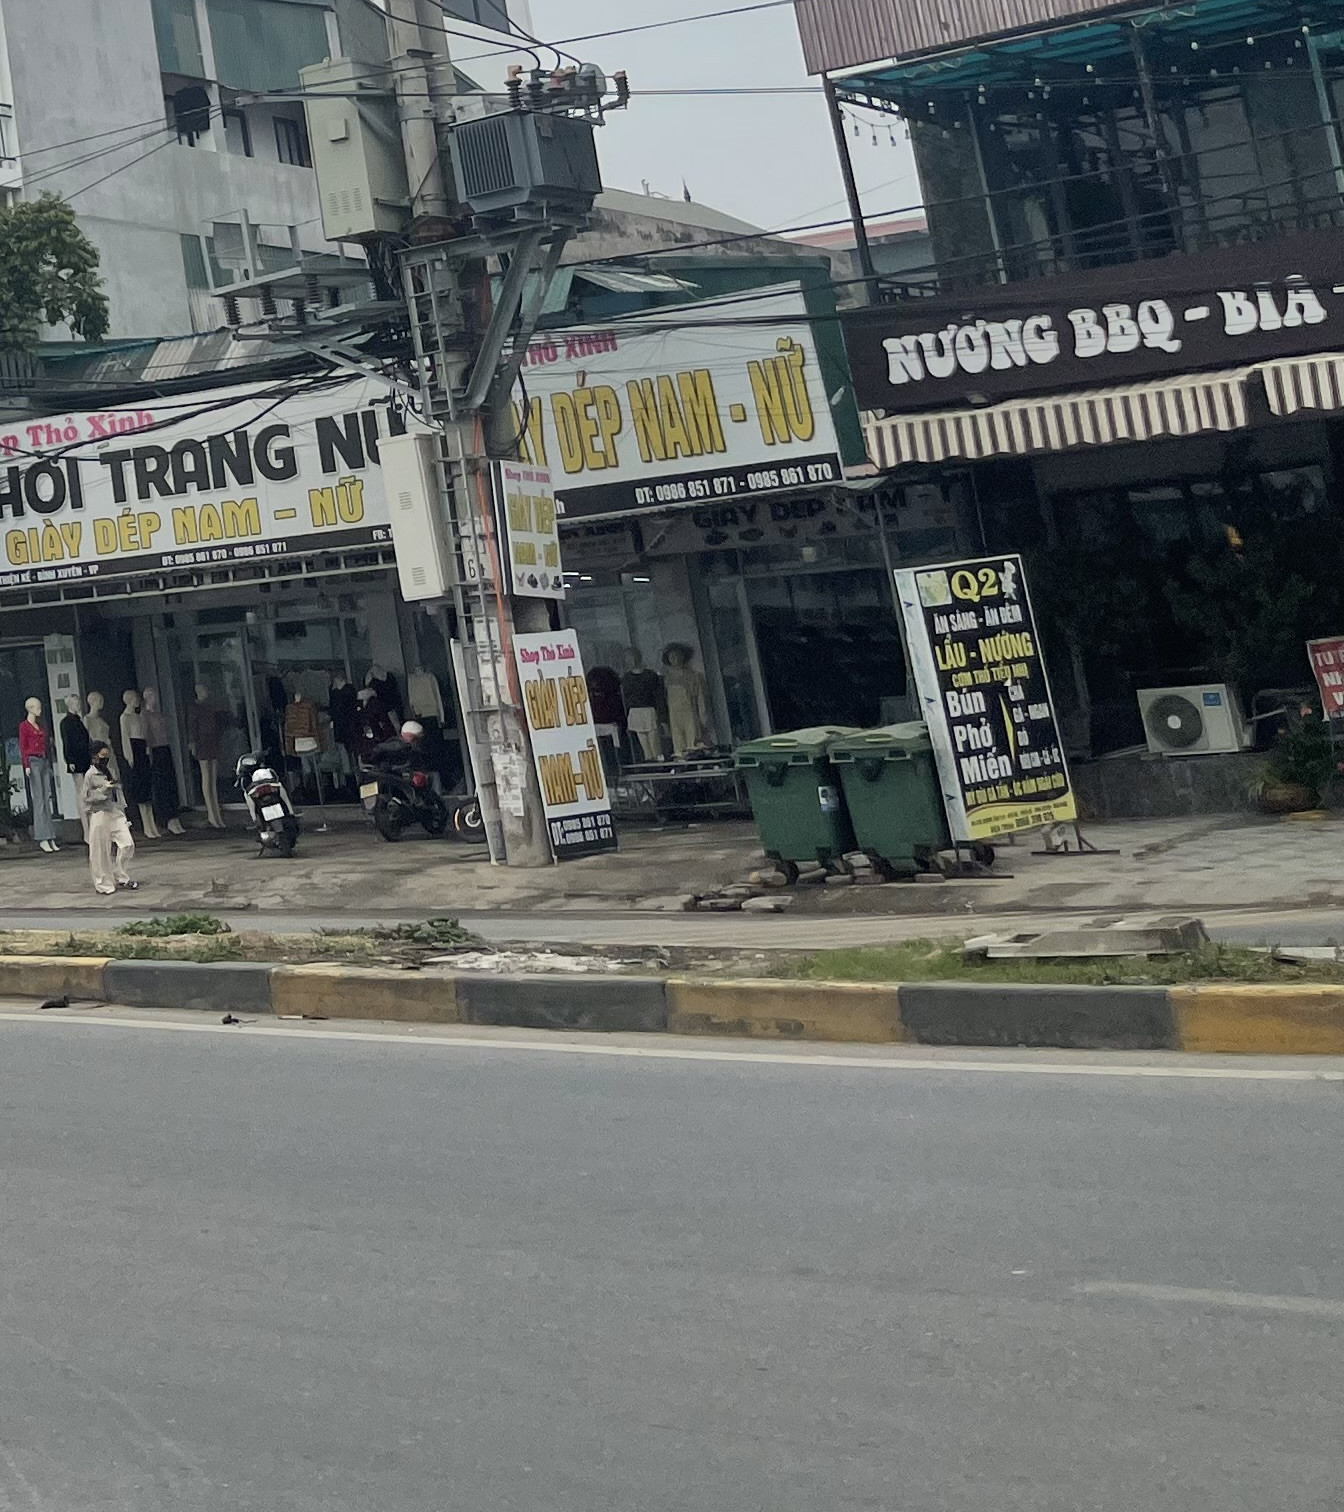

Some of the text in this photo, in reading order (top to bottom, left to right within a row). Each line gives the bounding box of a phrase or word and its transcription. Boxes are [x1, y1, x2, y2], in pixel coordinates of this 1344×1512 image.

[1067, 299, 1182, 358] BBQ
[1216, 275, 1328, 335] BIA
[550, 370, 621, 474] DÉP
[627, 368, 727, 463] NAM
[747, 335, 816, 446] NỮ
[26, 417, 79, 447] Thỏ
[86, 410, 156, 439] Xinh
[99, 423, 300, 505] TRANG
[655, 463, 833, 501] 0986 851 871 0985 861 870
[5, 474, 365, 565] GIÀY DÉP NAM NỮ
[950, 567, 999, 603] Q2
[949, 608, 978, 633] SÁNG
[558, 665, 589, 727] DÉP
[945, 687, 987, 718] Bún
[953, 717, 993, 753] Phở
[959, 746, 1013, 785] Miến
